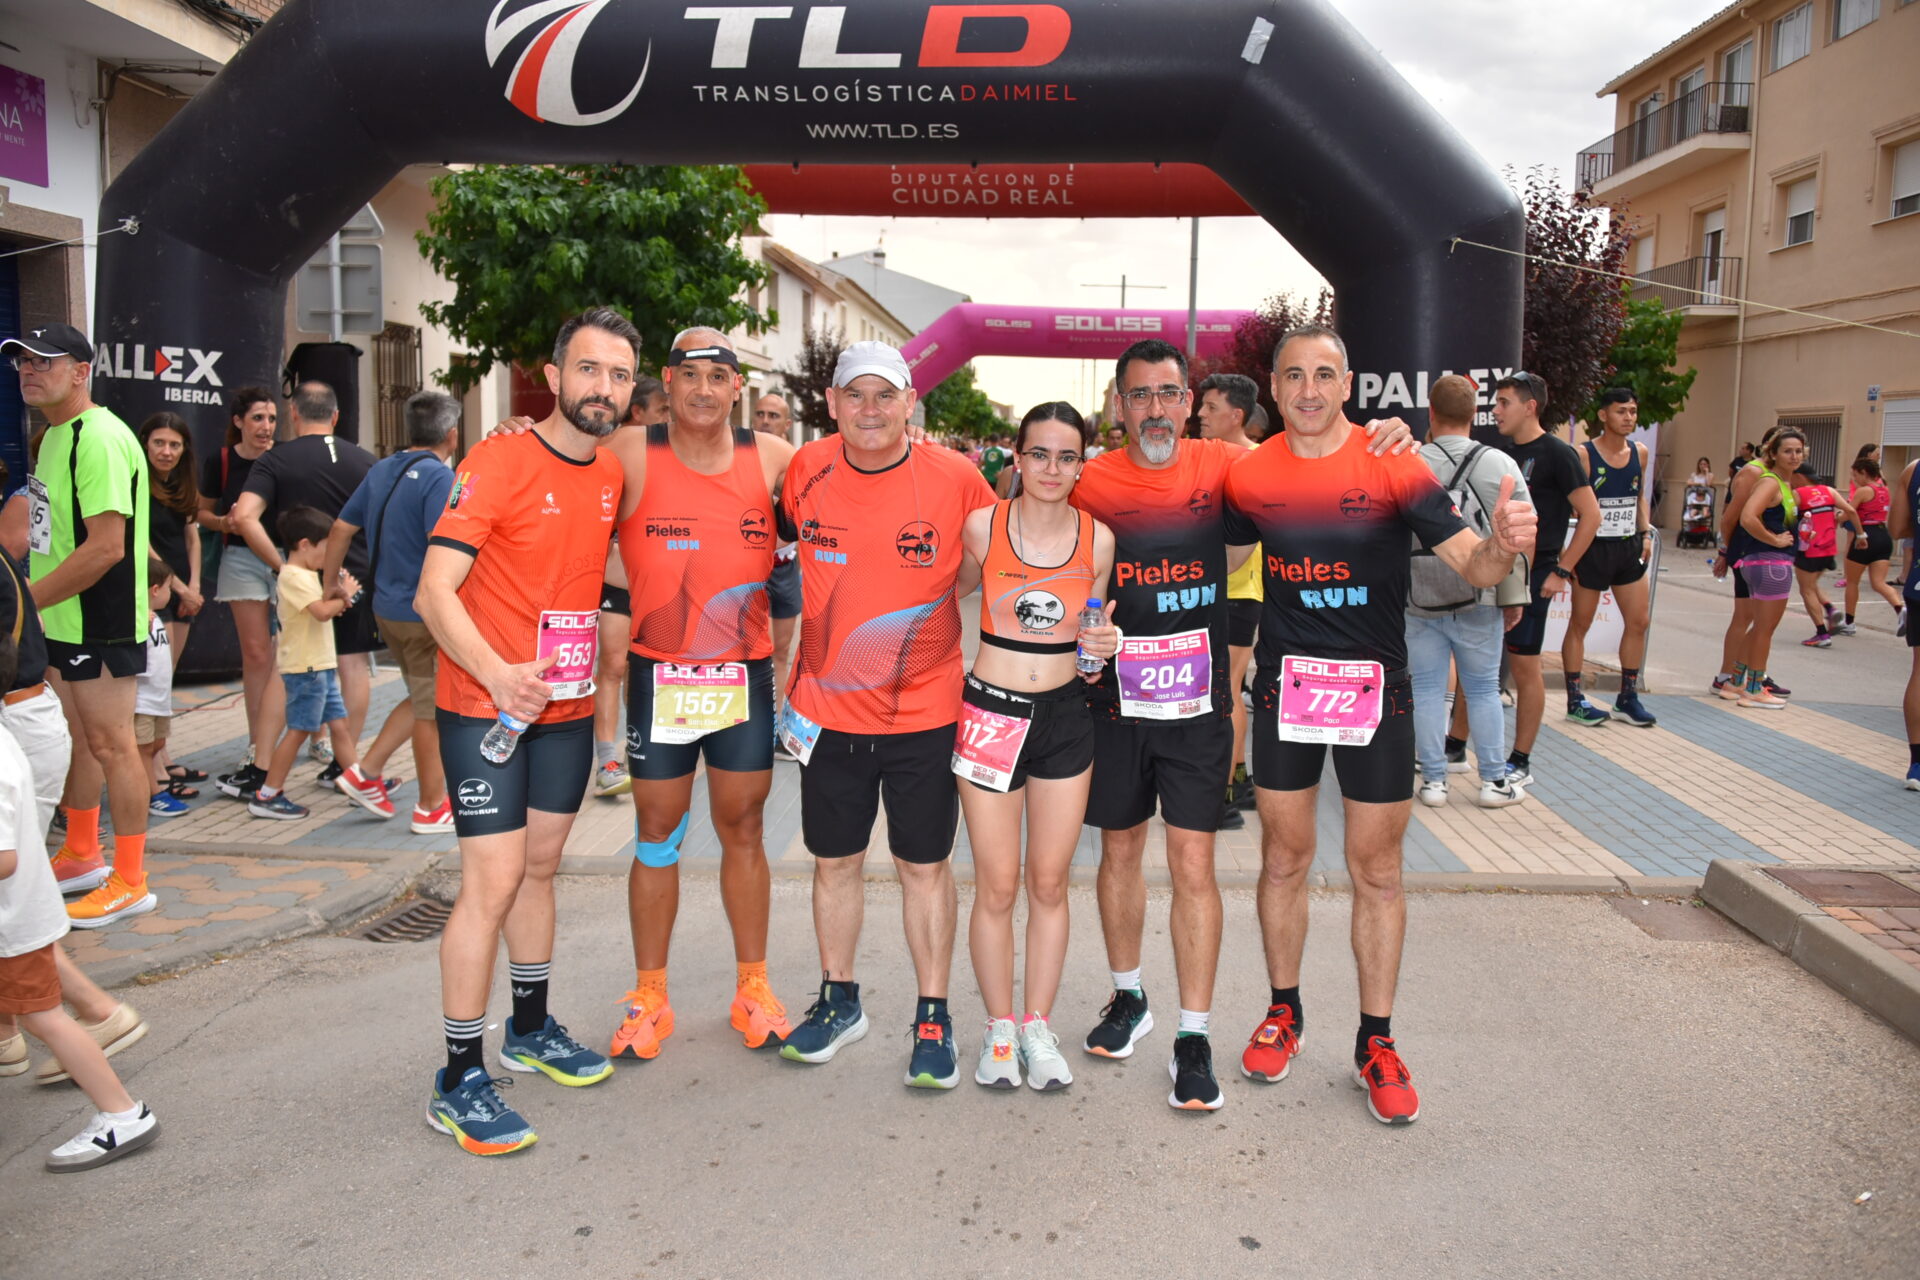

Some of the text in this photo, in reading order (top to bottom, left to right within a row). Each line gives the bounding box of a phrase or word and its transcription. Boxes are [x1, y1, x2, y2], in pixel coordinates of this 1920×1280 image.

[684, 4, 1072, 68] TLD
[806, 123, 959, 139] WWW.TLD.ES
[891, 172, 1075, 186] DIPUTACIÓN DE
[892, 188, 1074, 204] CIUDAD REAL
[985, 319, 1032, 329] SOLISS
[1055, 315, 1162, 332] SOLISS
[164, 387, 223, 406] IBERIA
[1604, 510, 1633, 522] 4848
[646, 525, 691, 537] Pieles
[667, 540, 700, 550] RUN
[815, 549, 848, 565] RUN
[1116, 558, 1204, 587] Pieles
[1267, 554, 1351, 583] Pieles
[1156, 583, 1216, 613] RUN
[1299, 586, 1367, 609] RUN
[1125, 635, 1202, 654] SOLISS
[663, 666, 739, 679] SOLISS
[1140, 662, 1194, 690] 204
[1291, 660, 1375, 678] SOLISS
[673, 692, 734, 716] 1567
[1307, 688, 1357, 713] 772
